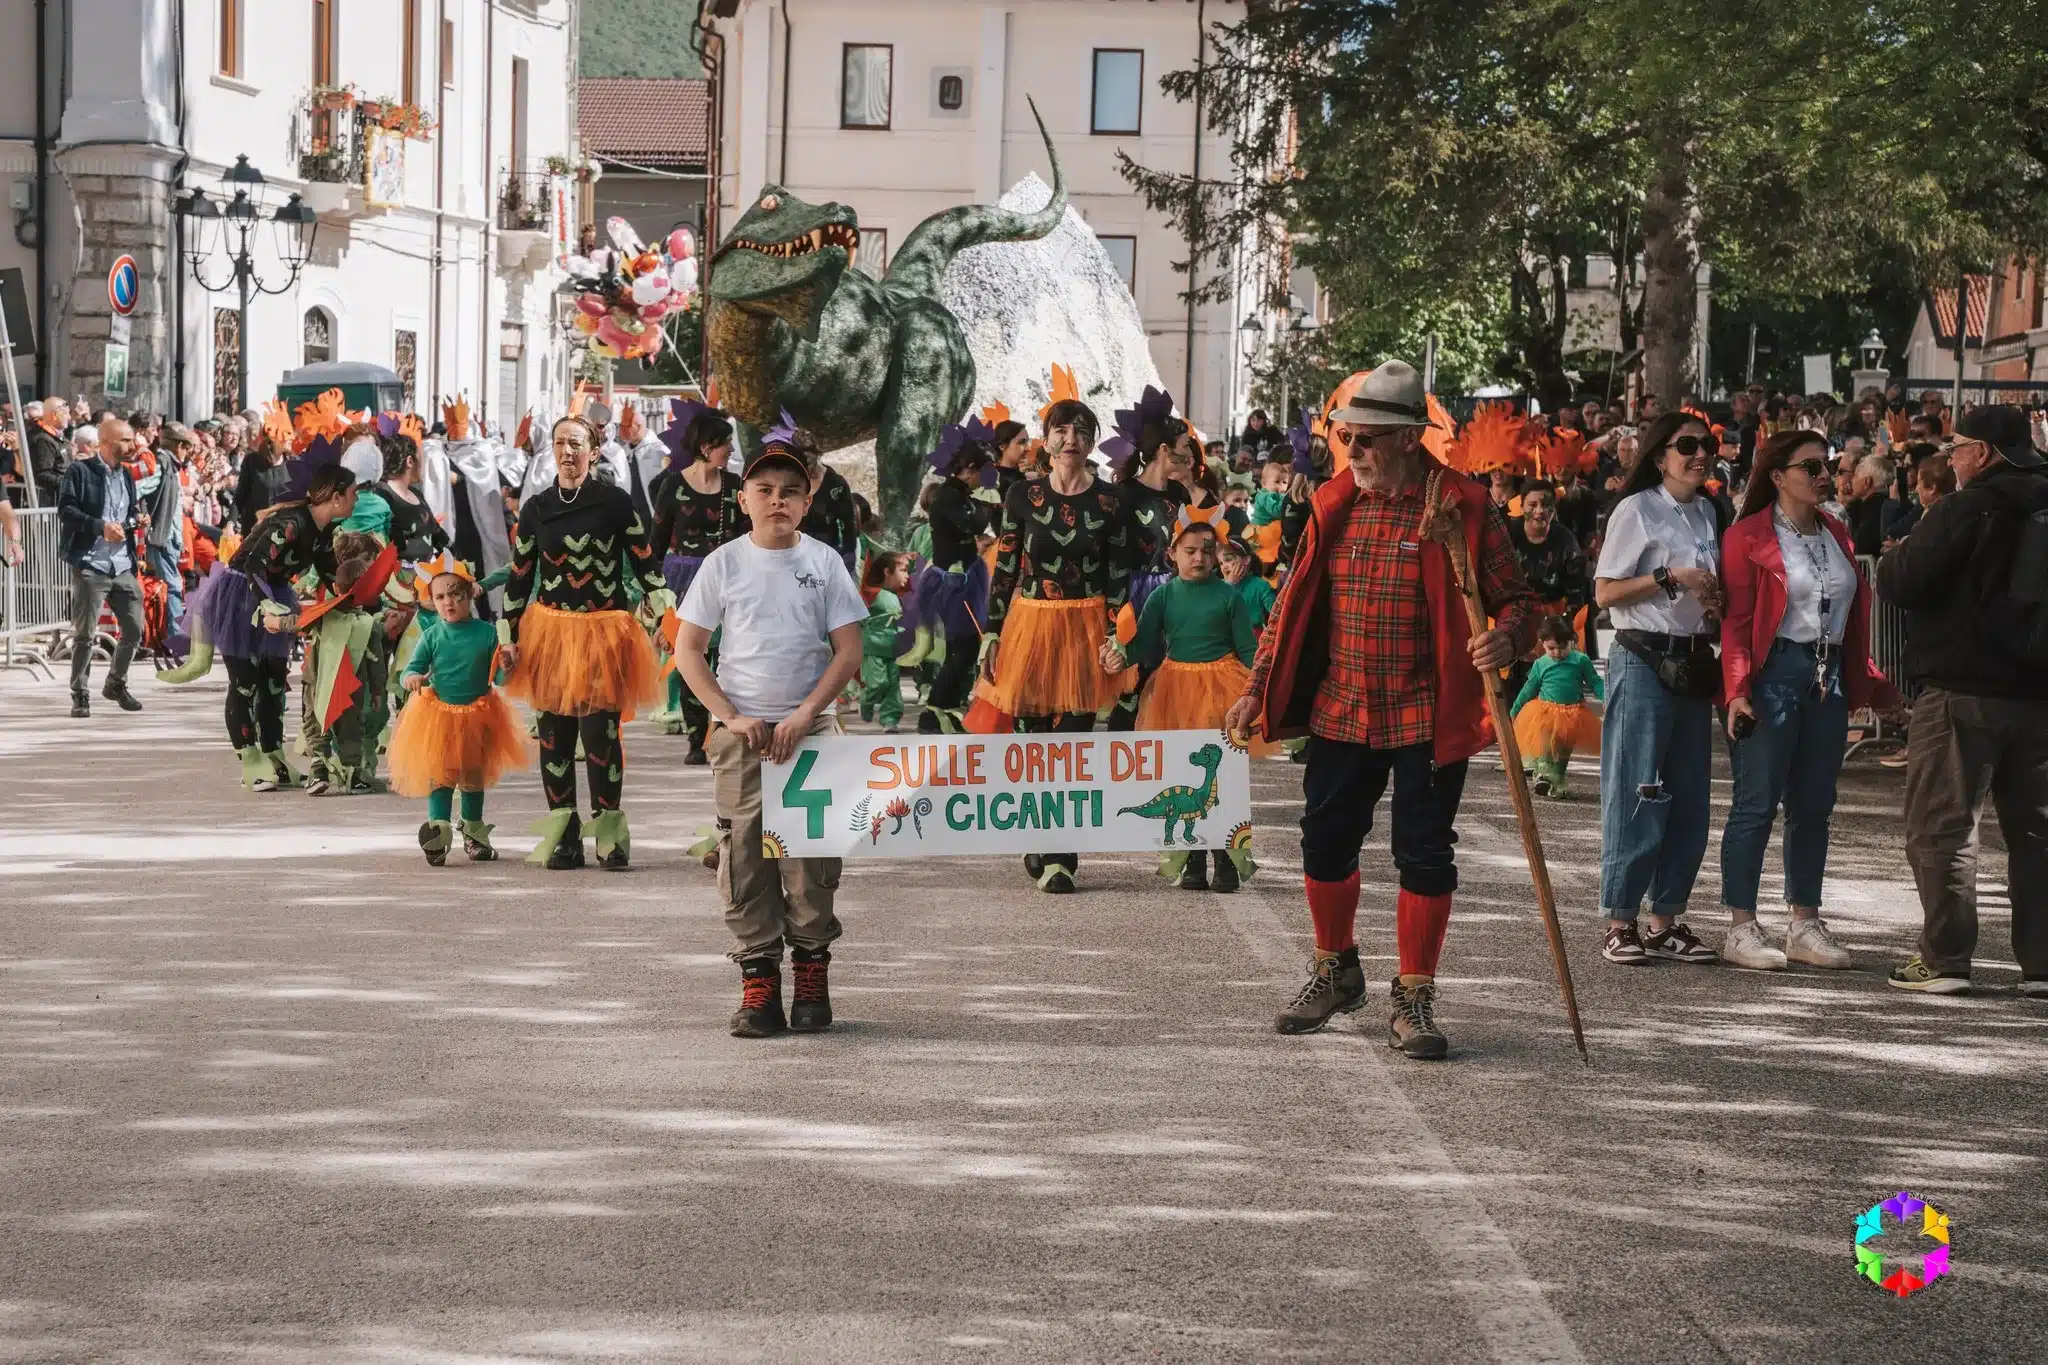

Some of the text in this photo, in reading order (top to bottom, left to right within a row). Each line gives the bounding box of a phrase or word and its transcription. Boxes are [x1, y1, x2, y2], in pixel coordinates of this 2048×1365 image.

[867, 740, 1164, 789] SULLE ORME DEI
[781, 750, 832, 840] 4
[945, 790, 1103, 831] GIGANTI
